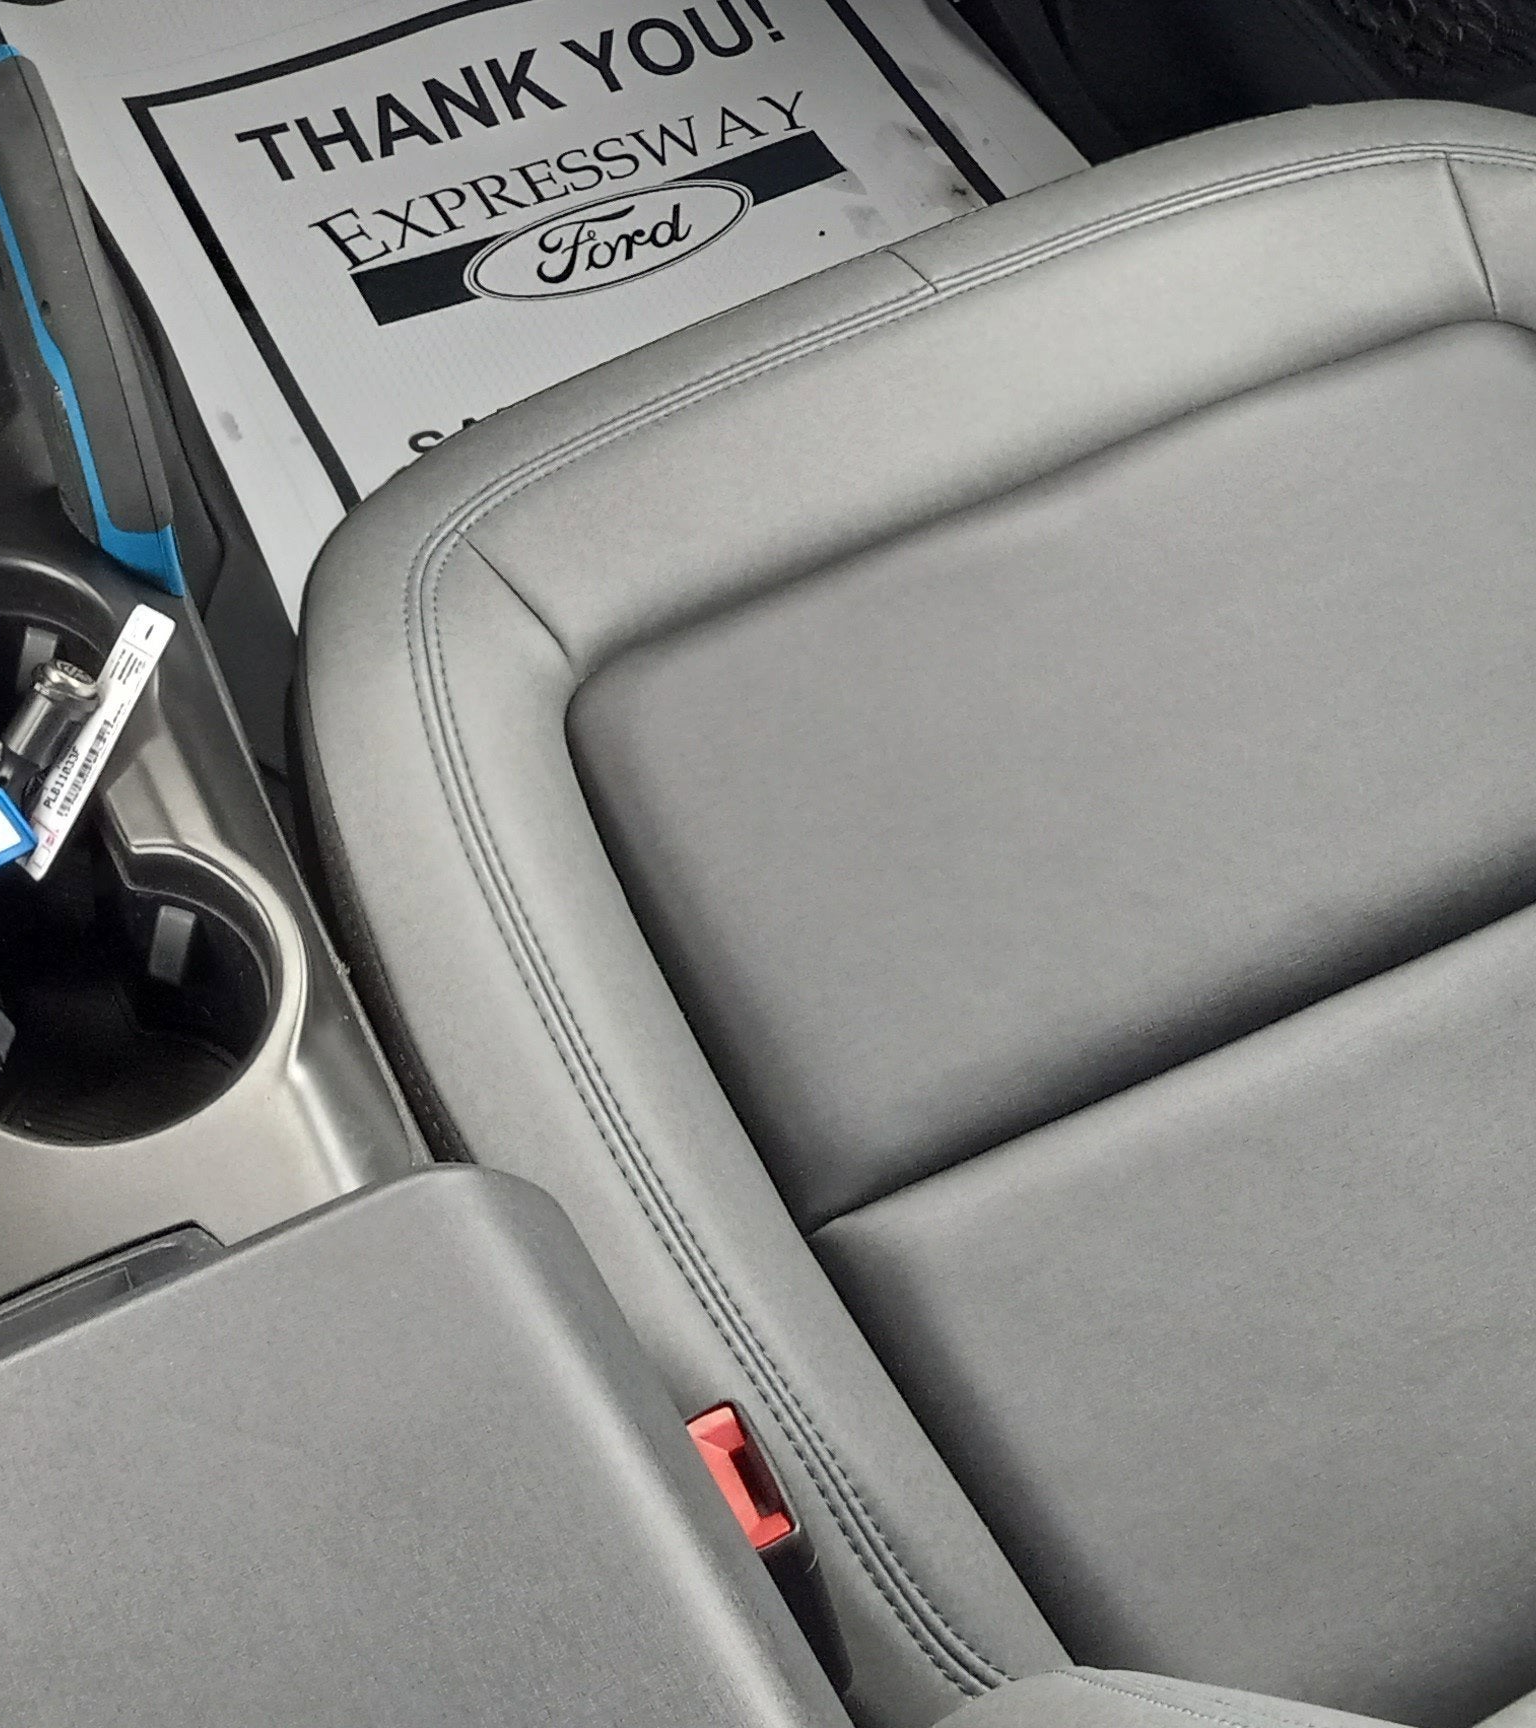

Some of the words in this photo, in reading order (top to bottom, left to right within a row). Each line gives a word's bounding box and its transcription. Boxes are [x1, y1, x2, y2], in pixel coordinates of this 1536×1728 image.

[235, 48, 567, 183] THANK
[308, 90, 809, 269] EXPRESSWAY
[535, 201, 694, 286] Ford
